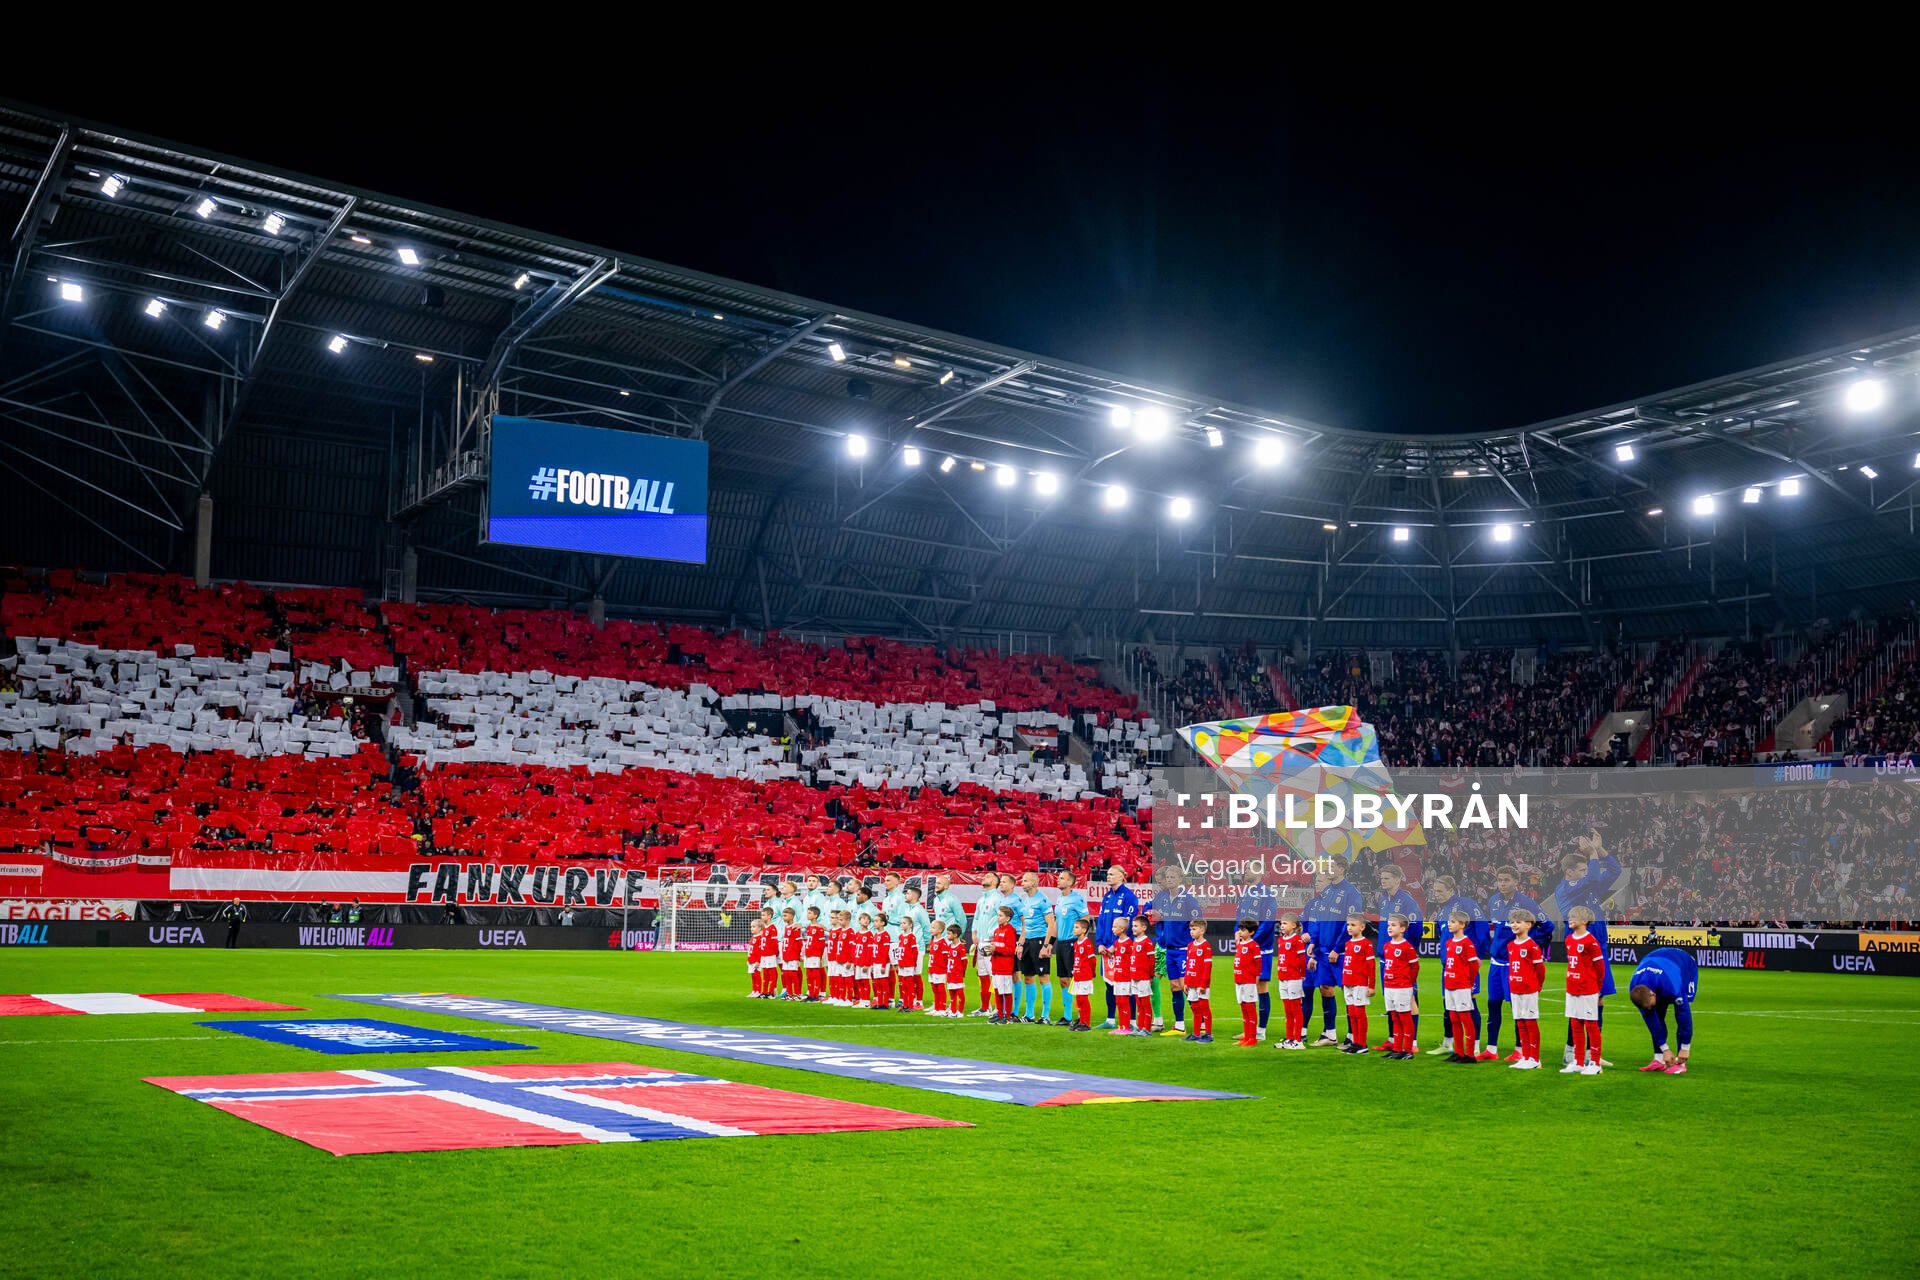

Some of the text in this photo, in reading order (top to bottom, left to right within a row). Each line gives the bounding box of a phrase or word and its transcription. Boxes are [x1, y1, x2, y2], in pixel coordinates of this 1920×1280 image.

[529, 467, 674, 514] #FOOTBALL
[1774, 763, 1832, 782] #FOOTBALL
[1875, 760, 1917, 775] UEFA
[405, 862, 648, 909] FANKURVE
[8, 905, 111, 920] EAGLES
[149, 926, 205, 944] UEFA
[300, 927, 394, 946] WELCOME ALL
[479, 929, 527, 946] UEFA
[1697, 950, 1765, 969] WELCOME ALL
[1833, 954, 1875, 972] UEFA
[693, 1041, 1073, 1084] LEAGUE
